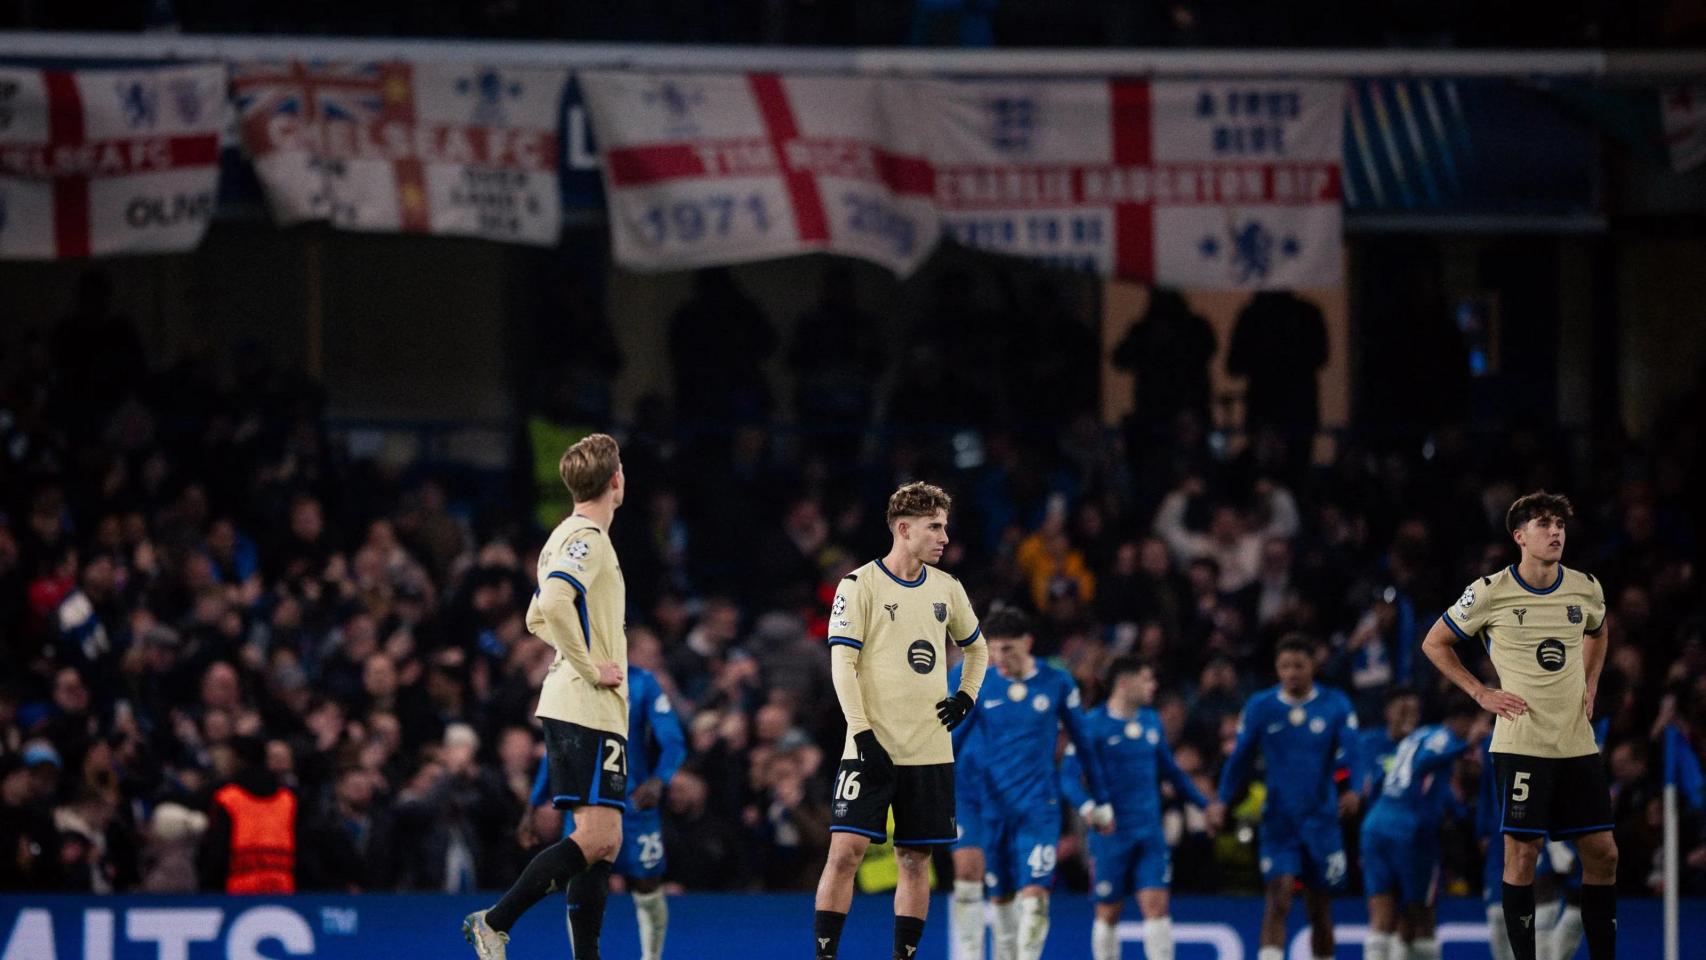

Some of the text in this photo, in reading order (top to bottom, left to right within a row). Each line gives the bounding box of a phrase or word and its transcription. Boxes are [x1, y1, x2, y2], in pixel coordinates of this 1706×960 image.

[266, 114, 545, 169] CHELSEA FC
[1212, 125, 1285, 153] BLUE
[644, 193, 769, 244] 1971
[835, 770, 861, 801] 16
[1512, 771, 1531, 801] 5
[1027, 844, 1056, 872] 49
